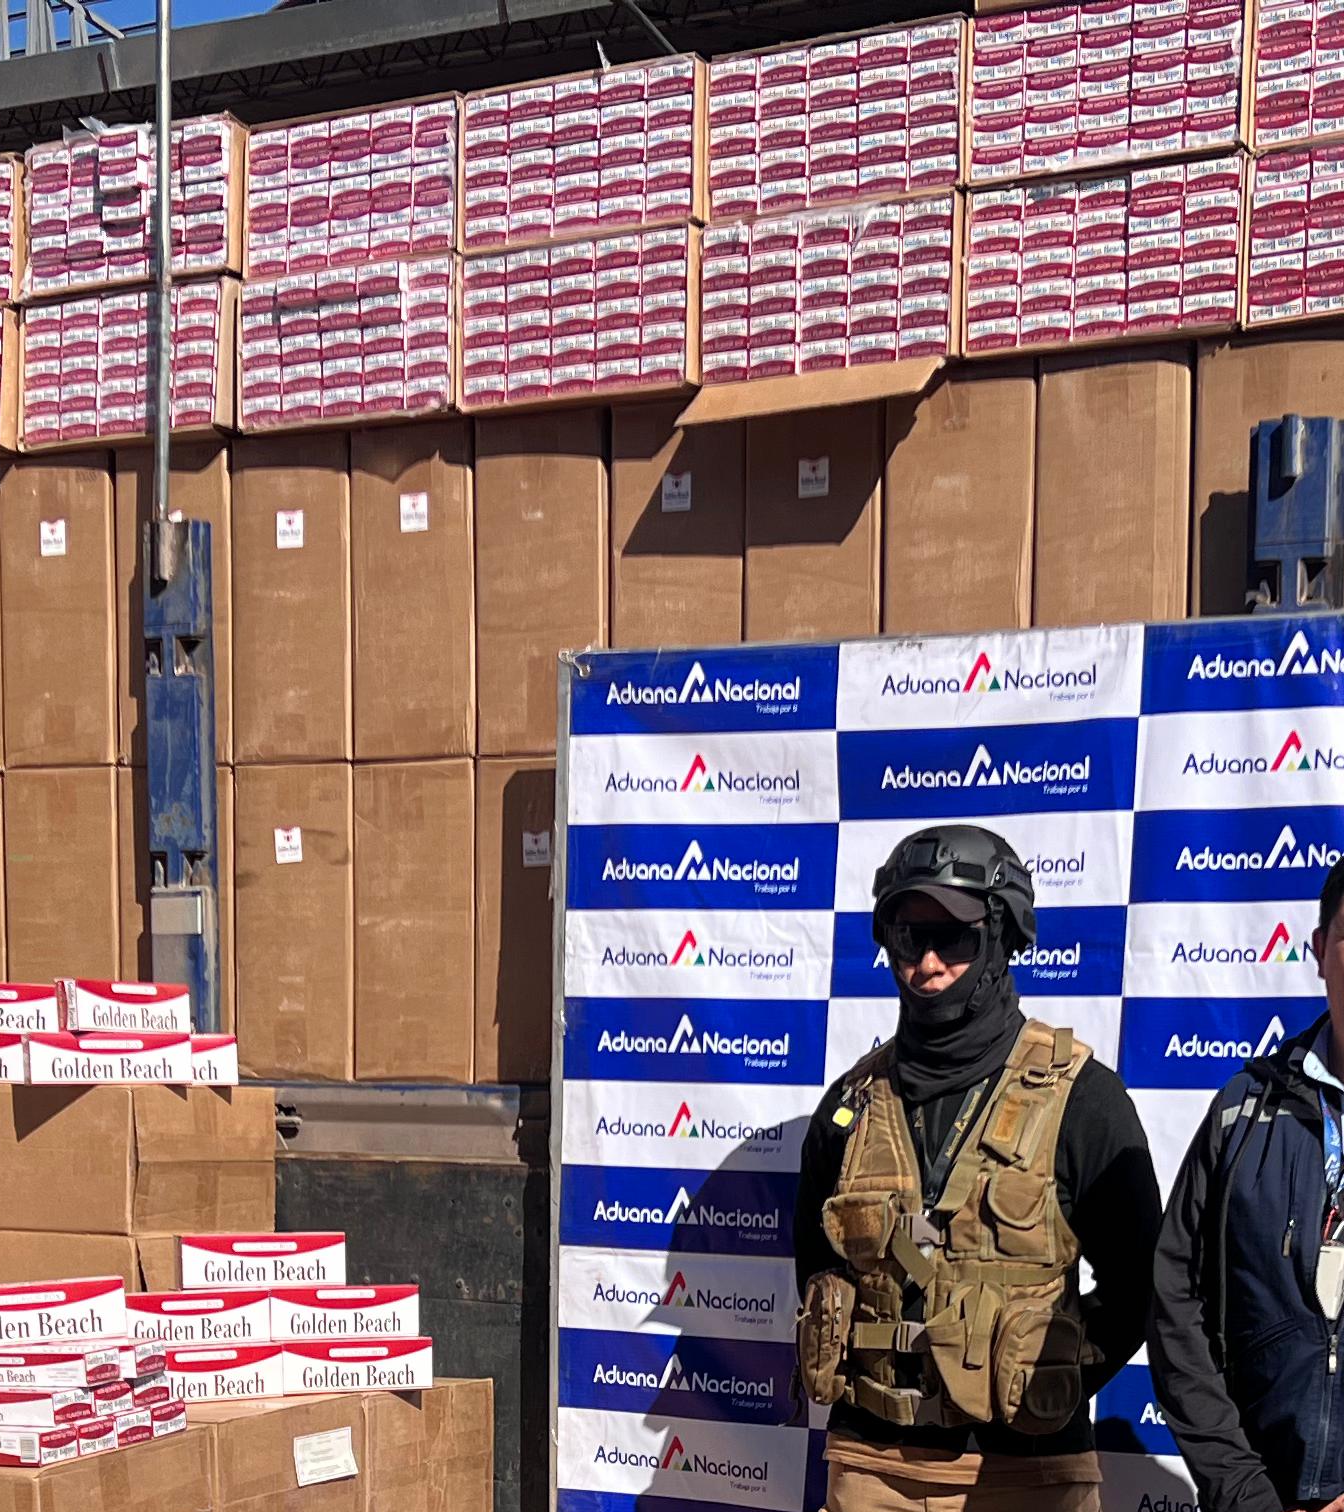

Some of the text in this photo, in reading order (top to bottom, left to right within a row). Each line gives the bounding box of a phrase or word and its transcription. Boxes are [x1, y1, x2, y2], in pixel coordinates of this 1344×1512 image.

[1188, 654, 1275, 680] Aduana
[607, 676, 800, 705] Aduana Nacional
[882, 664, 1096, 696] Aduana Nacional
[882, 755, 1090, 789] Aduana Nacional
[1183, 752, 1267, 775] Aduana
[605, 770, 799, 792] Aduana Nacional
[602, 857, 798, 880] Aduana Nacional
[1025, 852, 1085, 873] cional
[1176, 846, 1263, 870] Aduana
[602, 947, 793, 967] Aduana Nacional
[1172, 942, 1256, 963] Aduana
[93, 1005, 177, 1030] Golden Beach
[598, 1030, 789, 1055] Aduana Nacional
[1165, 1034, 1252, 1058] Aduana
[52, 1058, 113, 1078] Golden
[121, 1058, 172, 1079] Beach
[596, 1117, 782, 1141] Aduana Nacional
[594, 1200, 778, 1229] Aduana Nacional
[205, 1259, 326, 1282] Golden Beach
[594, 1283, 774, 1312] Aduana Nacional
[39, 1310, 103, 1336] Beach
[135, 1316, 251, 1341] Golden Beach
[291, 1312, 401, 1335] Golden Beach
[170, 1372, 264, 1399] lden Beach
[303, 1364, 414, 1388] Golden Beach
[594, 1363, 773, 1397] Aduana Nacional
